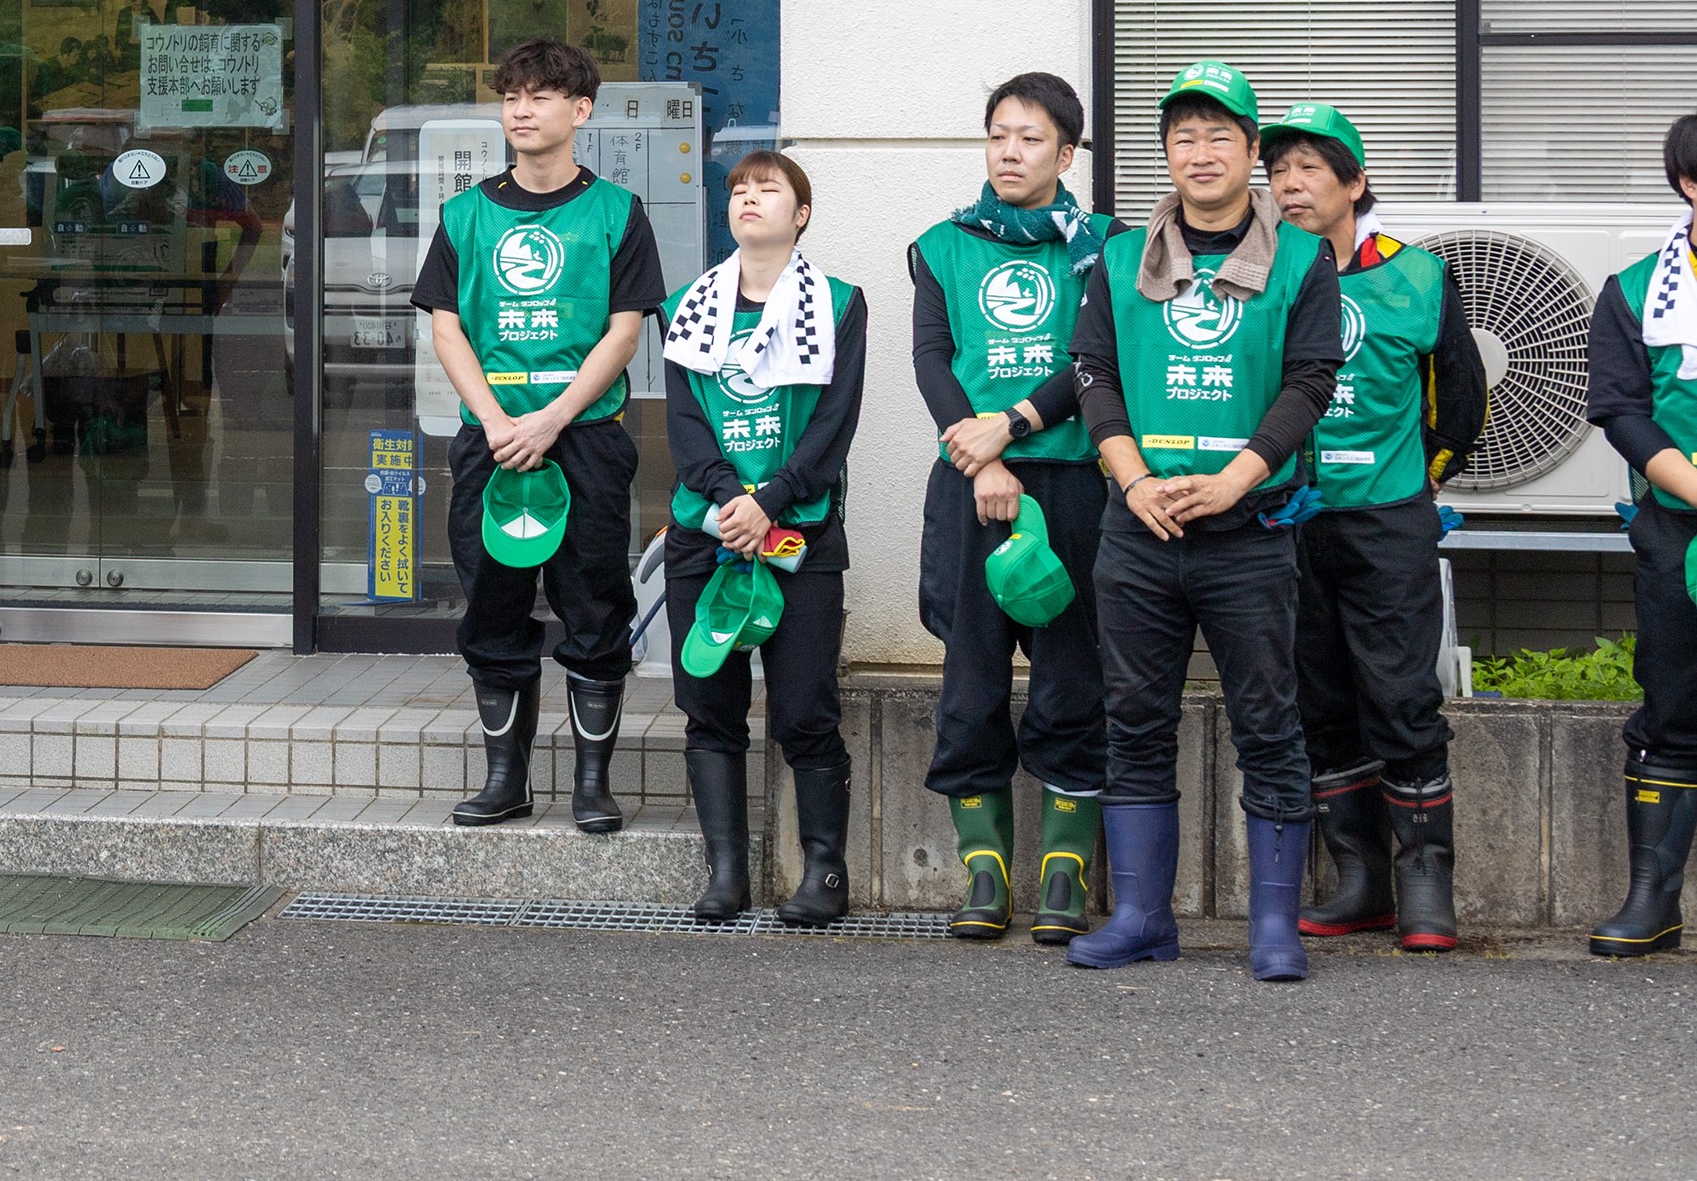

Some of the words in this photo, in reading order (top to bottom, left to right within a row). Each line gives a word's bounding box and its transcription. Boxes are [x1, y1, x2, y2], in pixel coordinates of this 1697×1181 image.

[146, 32, 261, 53] コウノトリの飼育に関する
[147, 55, 260, 75] お問い合せは、コウノトリ
[147, 76, 261, 96] 支援本部へお願いします
[627, 100, 638, 119] 日
[667, 99, 692, 119] 曜日
[610, 135, 630, 184] 体育館
[454, 151, 472, 193] 開館
[498, 309, 558, 329] 未来
[498, 329, 559, 341] プロジェクト
[987, 344, 1053, 366] 未来
[987, 366, 1054, 379] プロジェクト
[1166, 364, 1233, 387] 未来
[1166, 386, 1232, 401] プロジェクト
[1333, 383, 1355, 404] 来
[723, 415, 781, 439] 未来
[724, 437, 781, 452] プロジェクト
[380, 499, 392, 582] お入りください
[397, 500, 410, 594] 靴裏をよく拭いて
